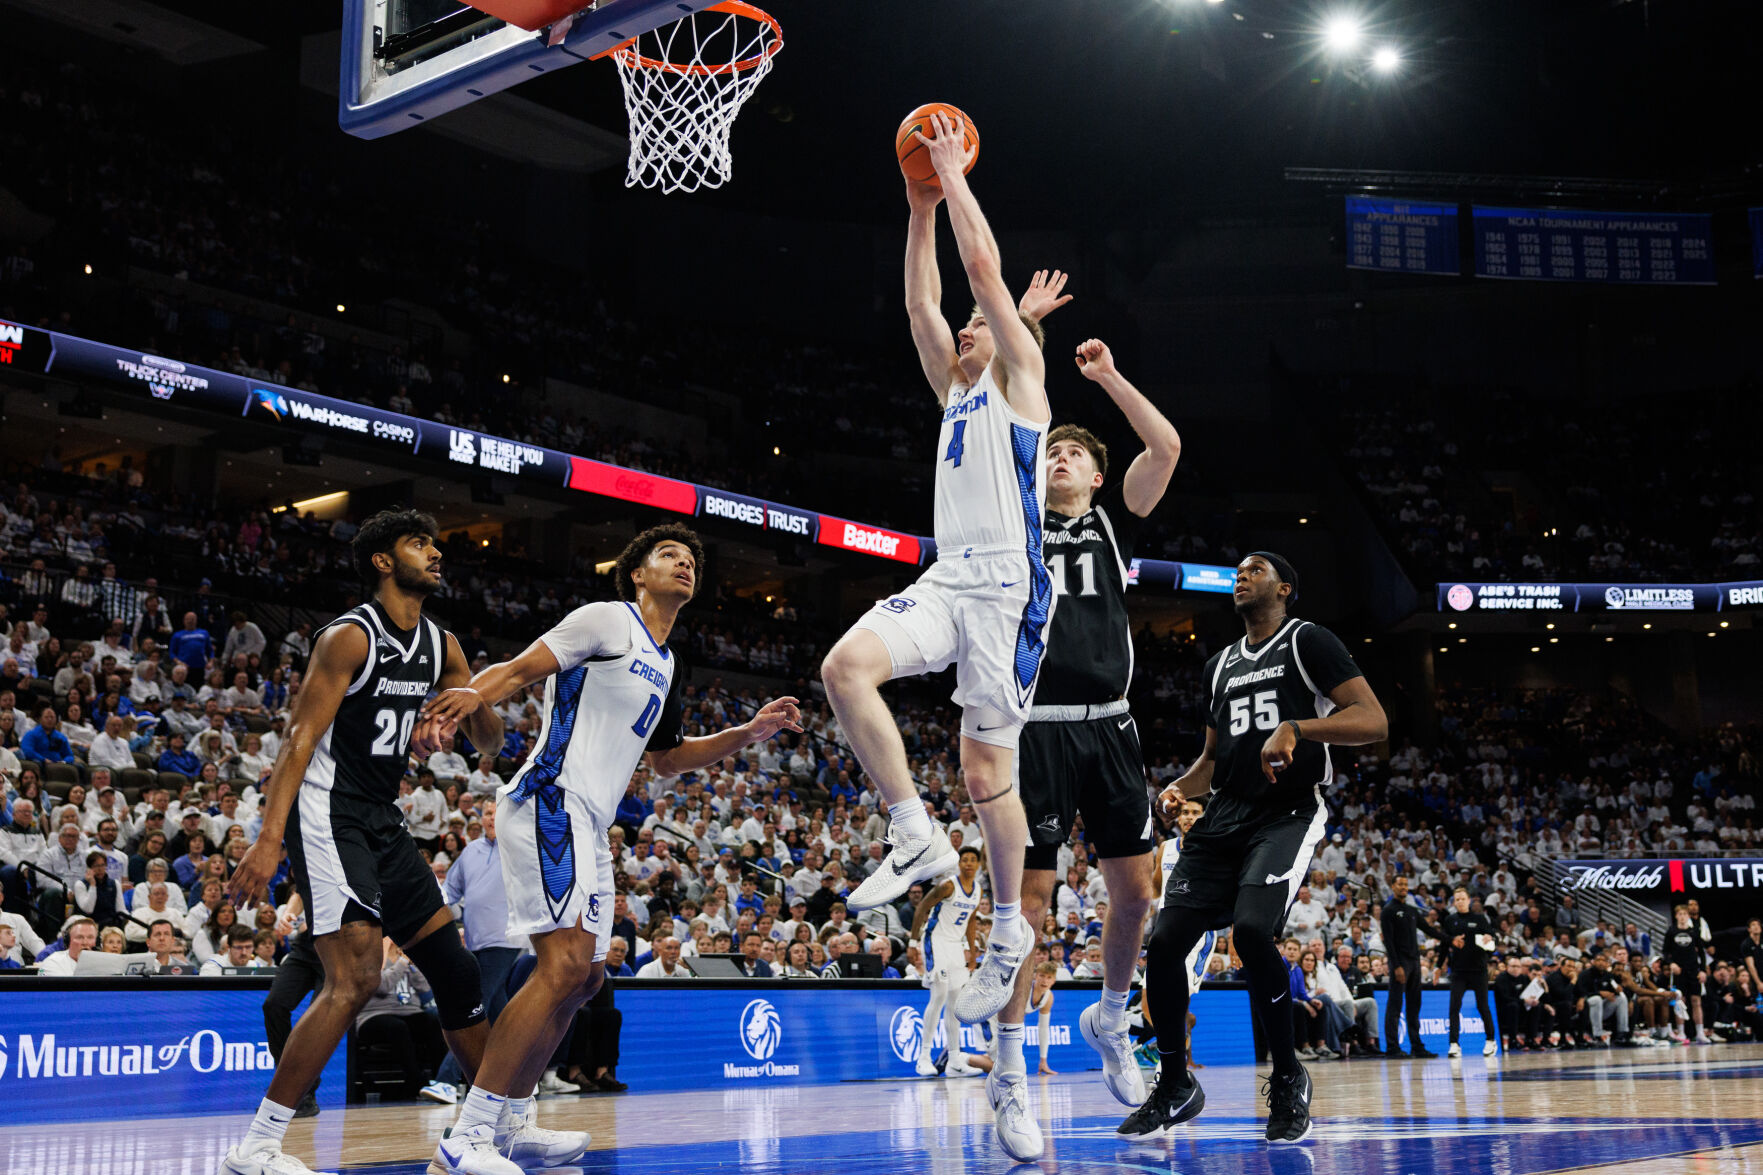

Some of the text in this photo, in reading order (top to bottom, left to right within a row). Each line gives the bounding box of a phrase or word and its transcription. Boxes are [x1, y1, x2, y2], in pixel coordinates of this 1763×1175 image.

[1366, 211, 1439, 226] APPEARANCES
[1508, 216, 1678, 232] NCAA TOURNAMENT APPEARANCES
[373, 420, 414, 439] CASINO
[480, 436, 544, 466] WE HELP YOU
[944, 420, 967, 469] 4
[480, 451, 510, 473] MAKE
[705, 495, 764, 526] BRIDGES
[843, 523, 900, 556] Baxter
[1047, 552, 1099, 597] 11
[1479, 598, 1563, 609] SERVICE INC.
[1517, 585, 1561, 597] TRASH
[1624, 588, 1694, 601] LIMITLESS
[372, 676, 430, 697] PROVIDENCE
[1223, 664, 1285, 694] PROVIDENCE
[630, 693, 662, 739] 0
[1229, 689, 1281, 737] 55
[371, 708, 417, 757] 20
[1559, 865, 1665, 893] Michelob
[954, 911, 969, 925] 2
